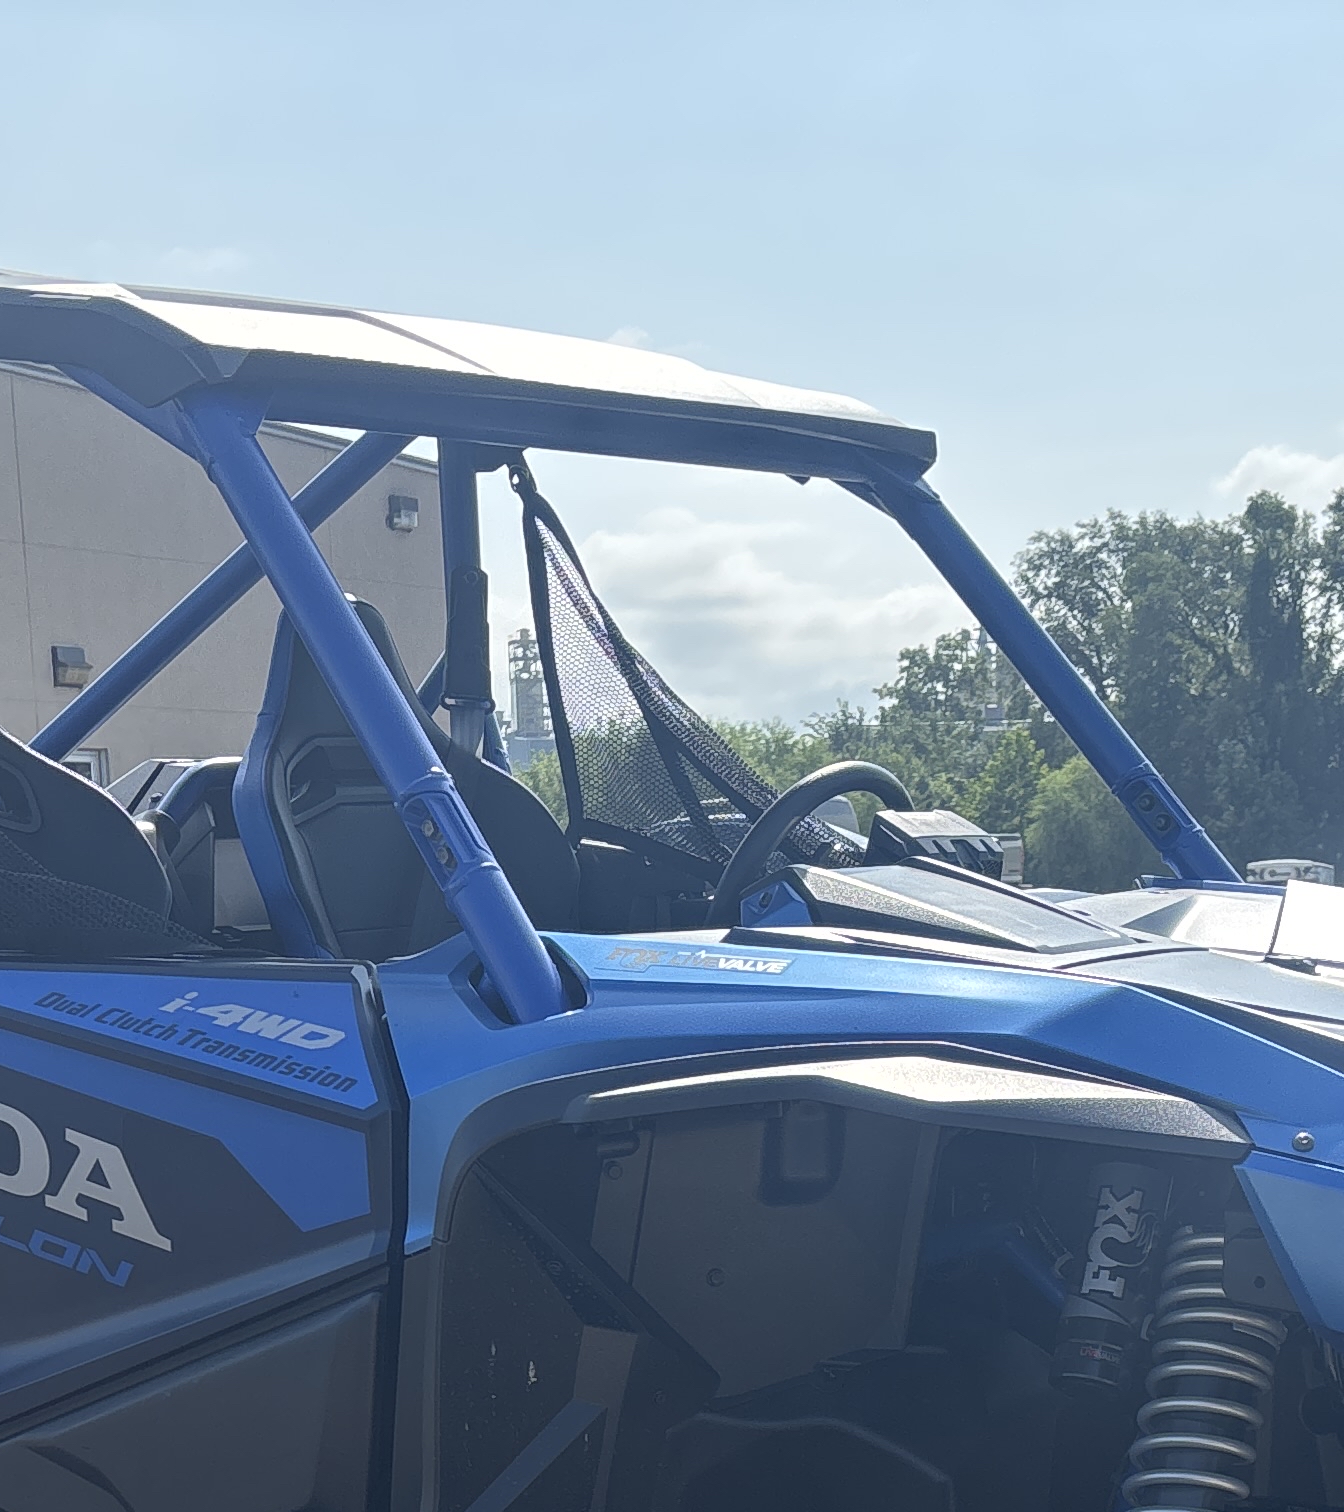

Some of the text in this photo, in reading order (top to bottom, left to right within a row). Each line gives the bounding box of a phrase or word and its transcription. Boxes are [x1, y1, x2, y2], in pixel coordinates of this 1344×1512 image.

[34, 991, 358, 1093] Dual Clutch Transmission
[159, 991, 346, 1051] i-4WD
[1081, 1187, 1155, 1299] FOX
